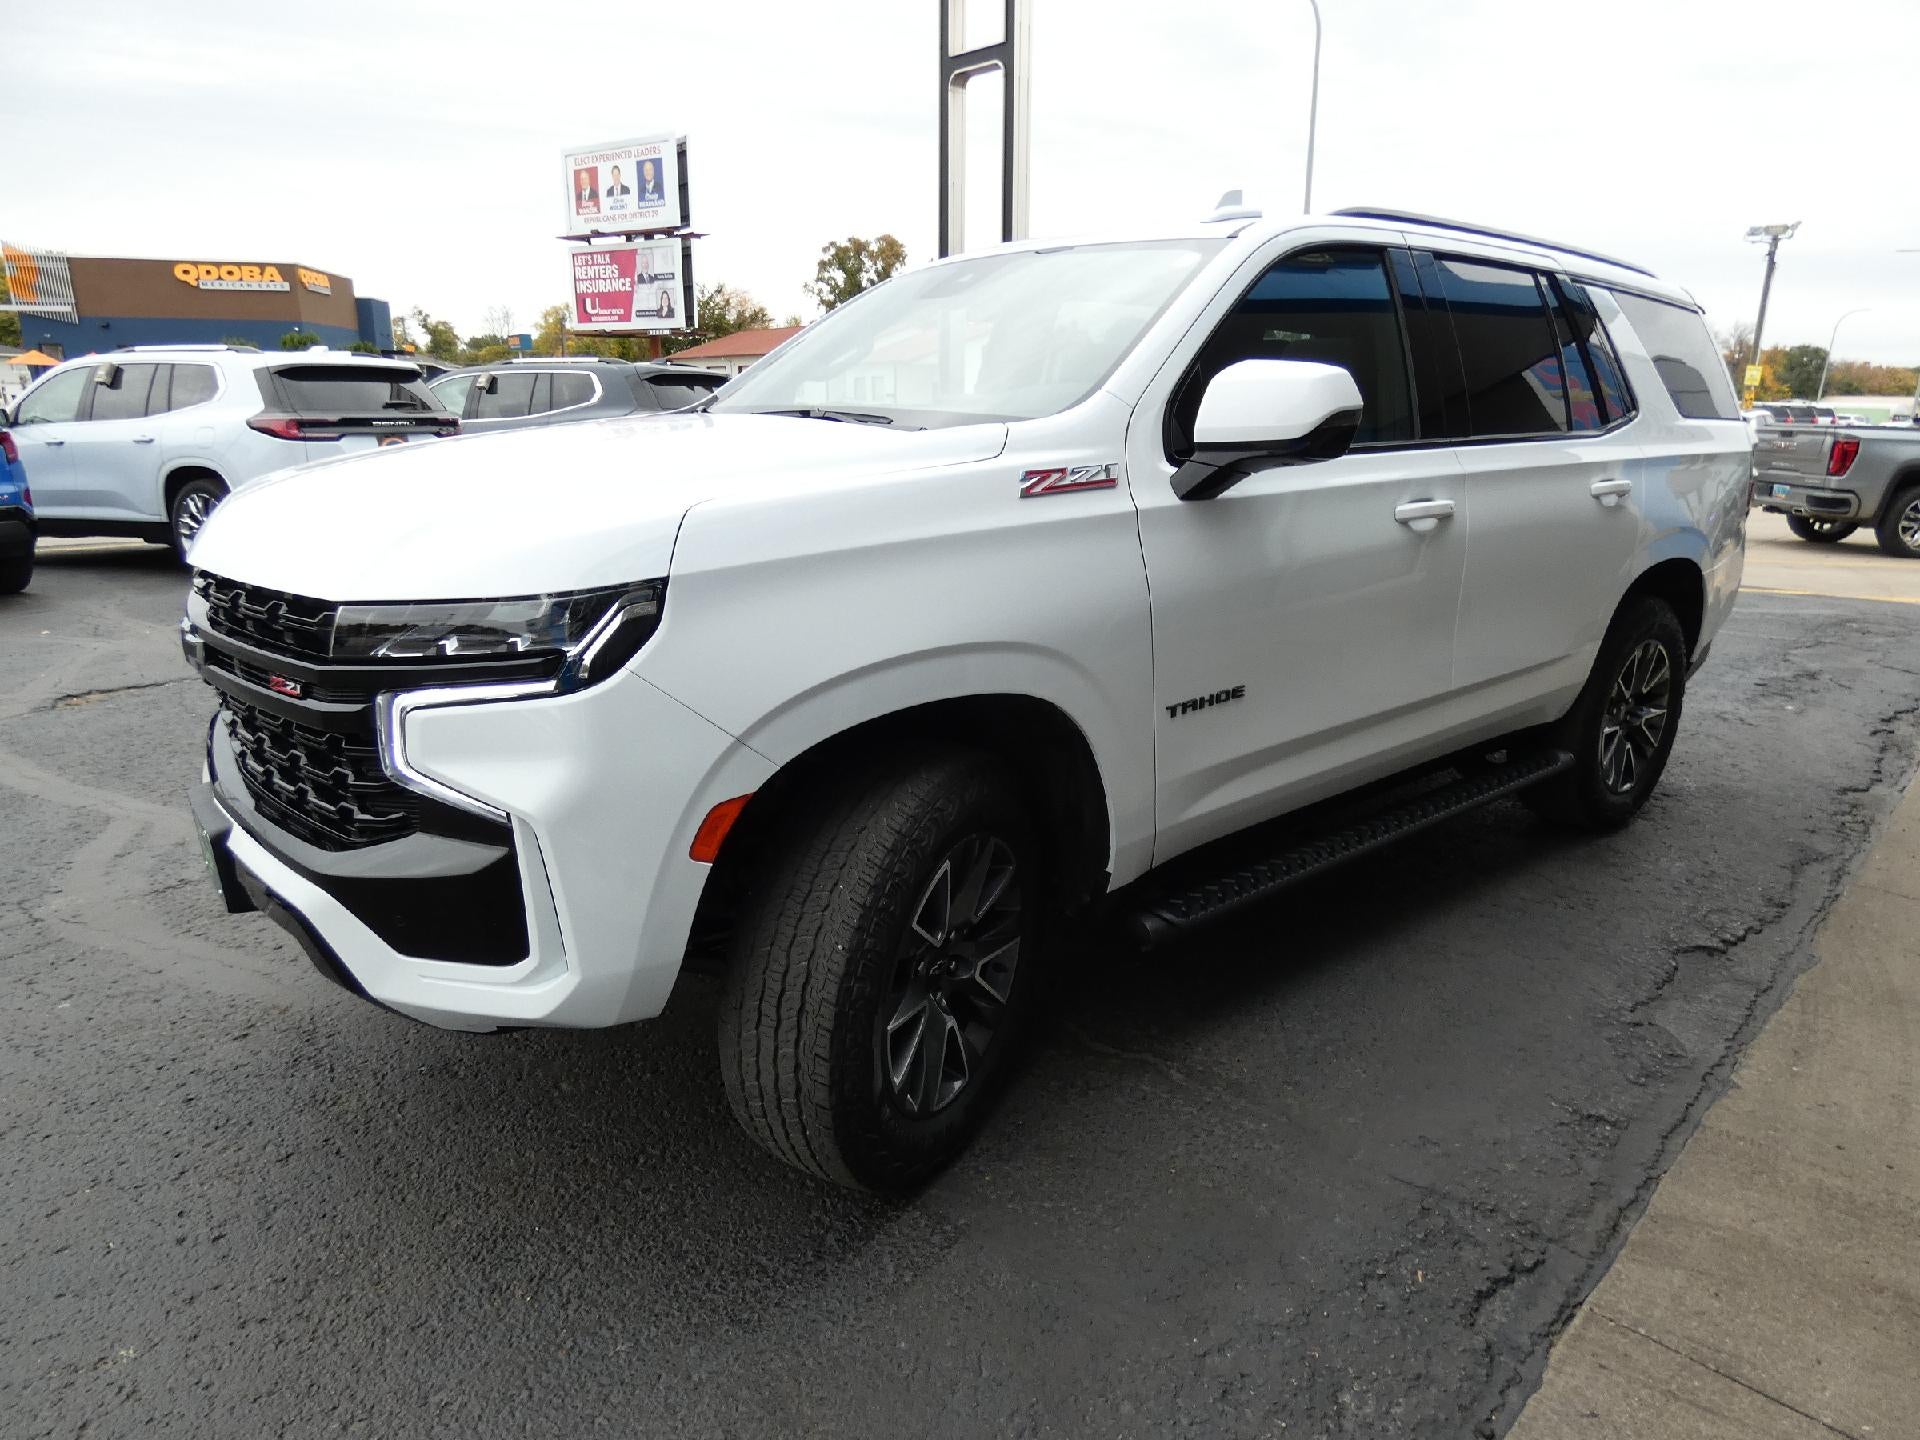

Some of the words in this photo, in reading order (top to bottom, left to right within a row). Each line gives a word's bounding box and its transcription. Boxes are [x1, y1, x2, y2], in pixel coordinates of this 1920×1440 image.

[591, 149, 633, 163] EXPERIENCED
[633, 145, 662, 158] LEADERS
[574, 255, 592, 266] LET'S
[593, 253, 611, 265] TALK
[173, 263, 284, 287] QDOBA
[575, 264, 619, 280] RENTERS
[201, 280, 253, 289] MEXICAN
[257, 282, 286, 290] EATS
[576, 278, 632, 294] INSURANCE
[1019, 462, 1119, 498] Z71
[1165, 685, 1246, 719] TAHOE
